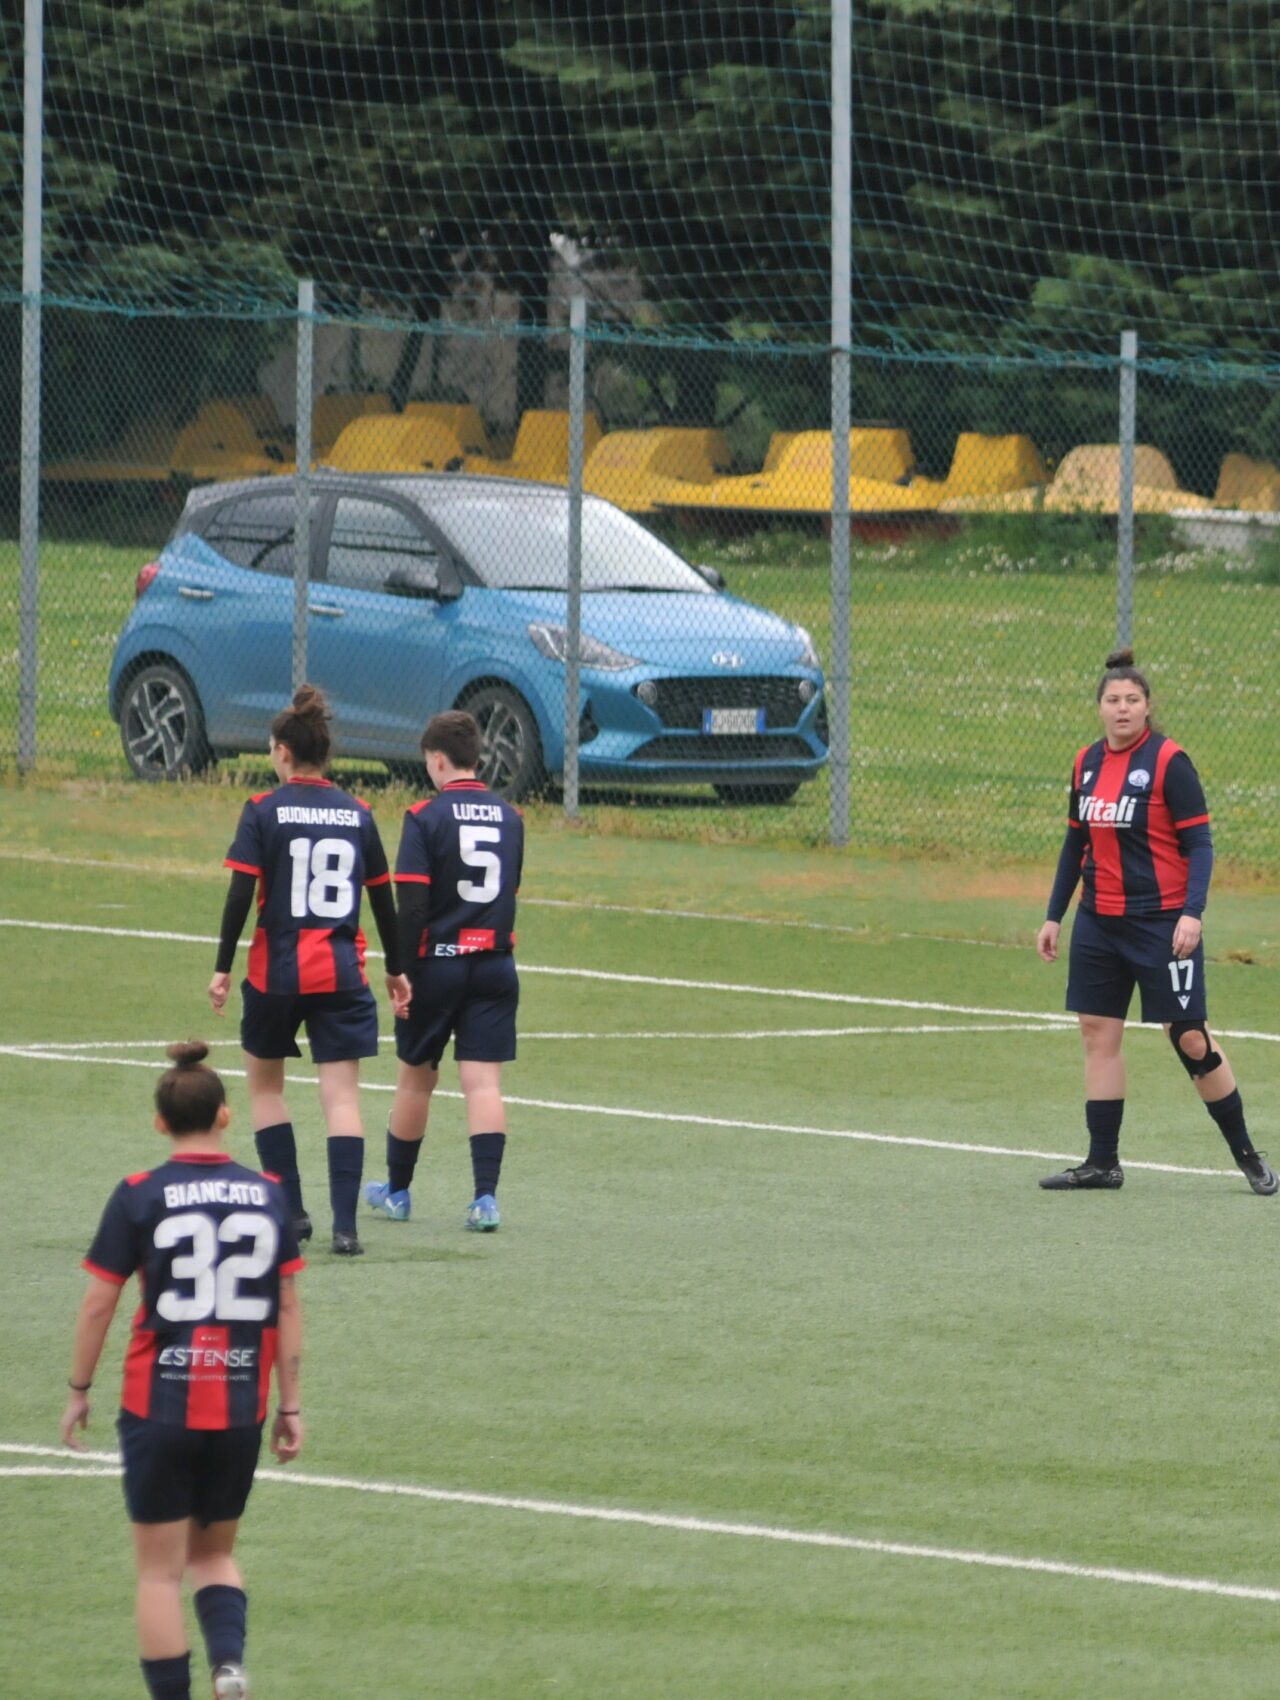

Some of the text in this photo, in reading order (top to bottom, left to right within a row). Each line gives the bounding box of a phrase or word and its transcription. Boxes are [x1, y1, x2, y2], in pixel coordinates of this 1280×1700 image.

[276, 806, 361, 828] BUONAMASSA
[452, 803, 503, 822] LUCCHI
[1079, 795, 1137, 821] Vitali
[457, 825, 501, 903] 5
[289, 837, 356, 919] 18
[1168, 959, 1194, 993] 17
[163, 1182, 265, 1208] BIANCATO
[153, 1211, 278, 1322] 32
[158, 1348, 255, 1367] ESTENSE
